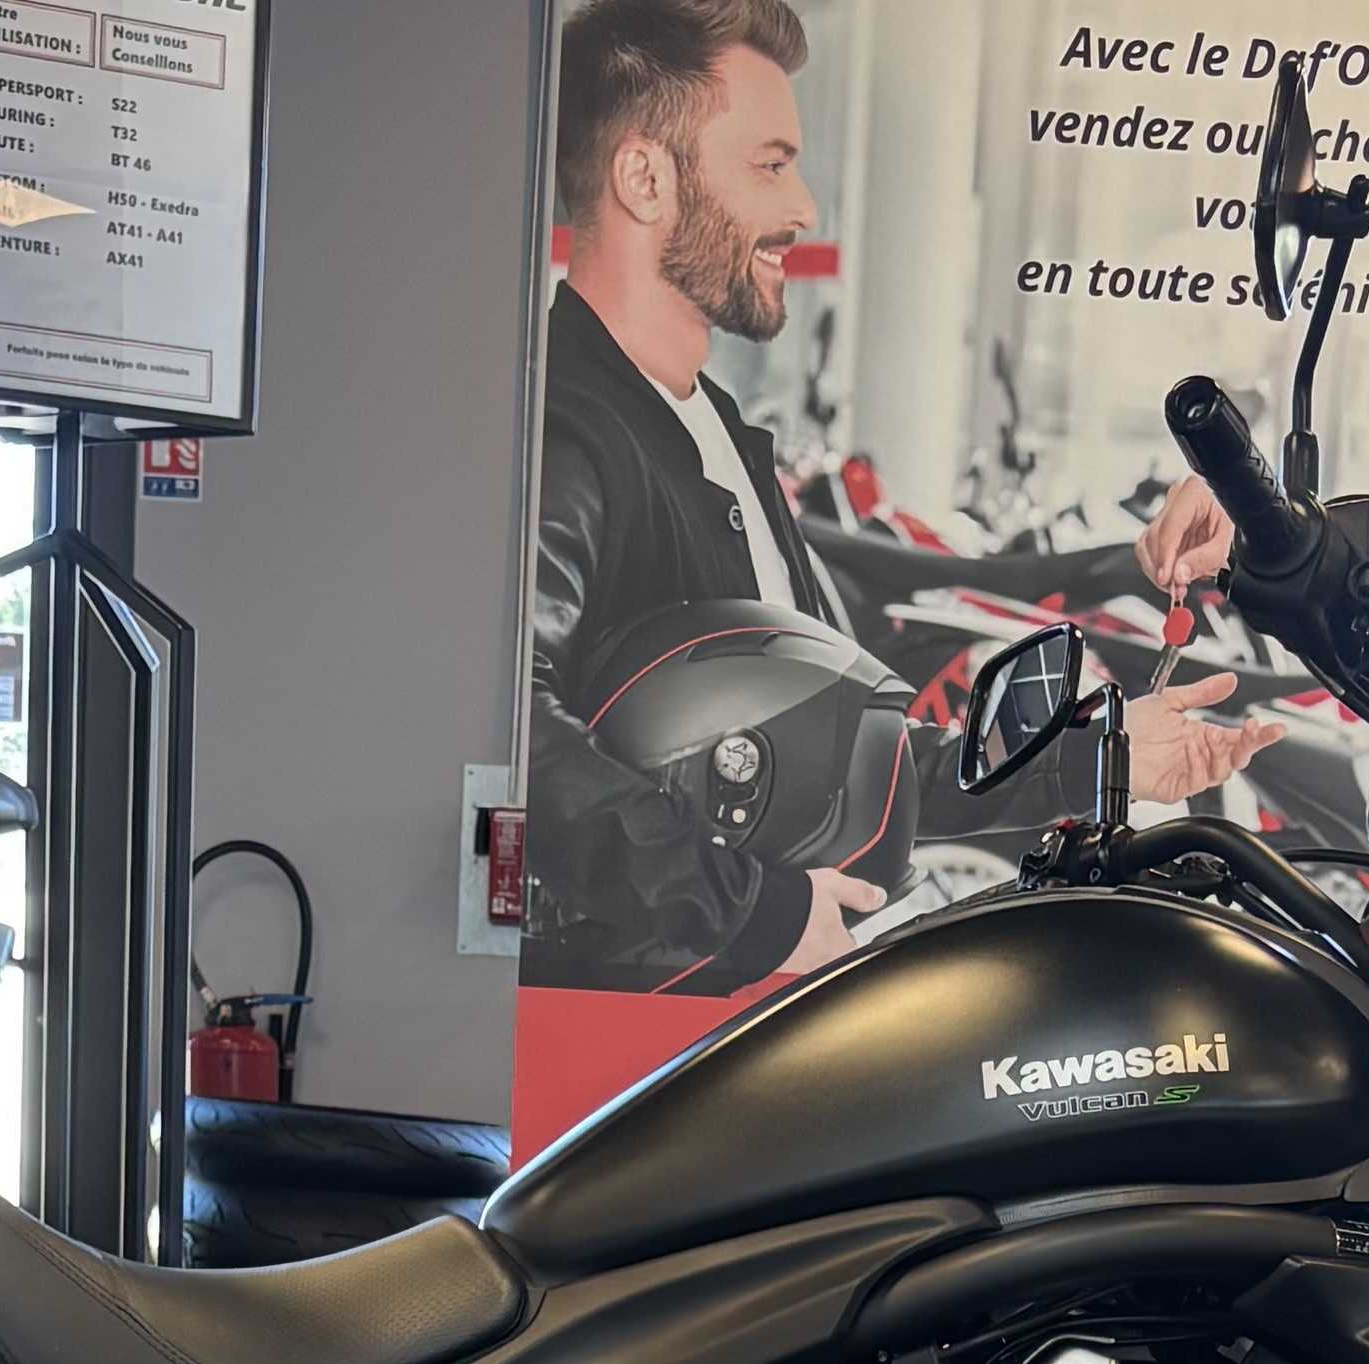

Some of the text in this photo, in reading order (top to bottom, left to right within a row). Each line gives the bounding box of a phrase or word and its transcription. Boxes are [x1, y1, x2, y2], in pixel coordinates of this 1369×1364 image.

[113, 25, 188, 50] Nous vous
[1061, 27, 1174, 75] Avec
[1186, 33, 1229, 76] le
[111, 97, 138, 114] S22
[111, 125, 138, 142] T32
[1030, 106, 1194, 151] vendez
[1206, 121, 1263, 156] ou
[111, 153, 130, 169] BT
[133, 156, 152, 171] 46
[108, 190, 137, 207] H50
[151, 198, 199, 217] Exedra
[107, 221, 143, 240] AT41
[156, 229, 184, 245] A41
[107, 251, 143, 268] AX41
[1017, 259, 1074, 295] en
[1088, 259, 1214, 302] toute
[981, 1033, 1230, 1100] Kawasaki
[1018, 1085, 1200, 1121] Vulcan S
